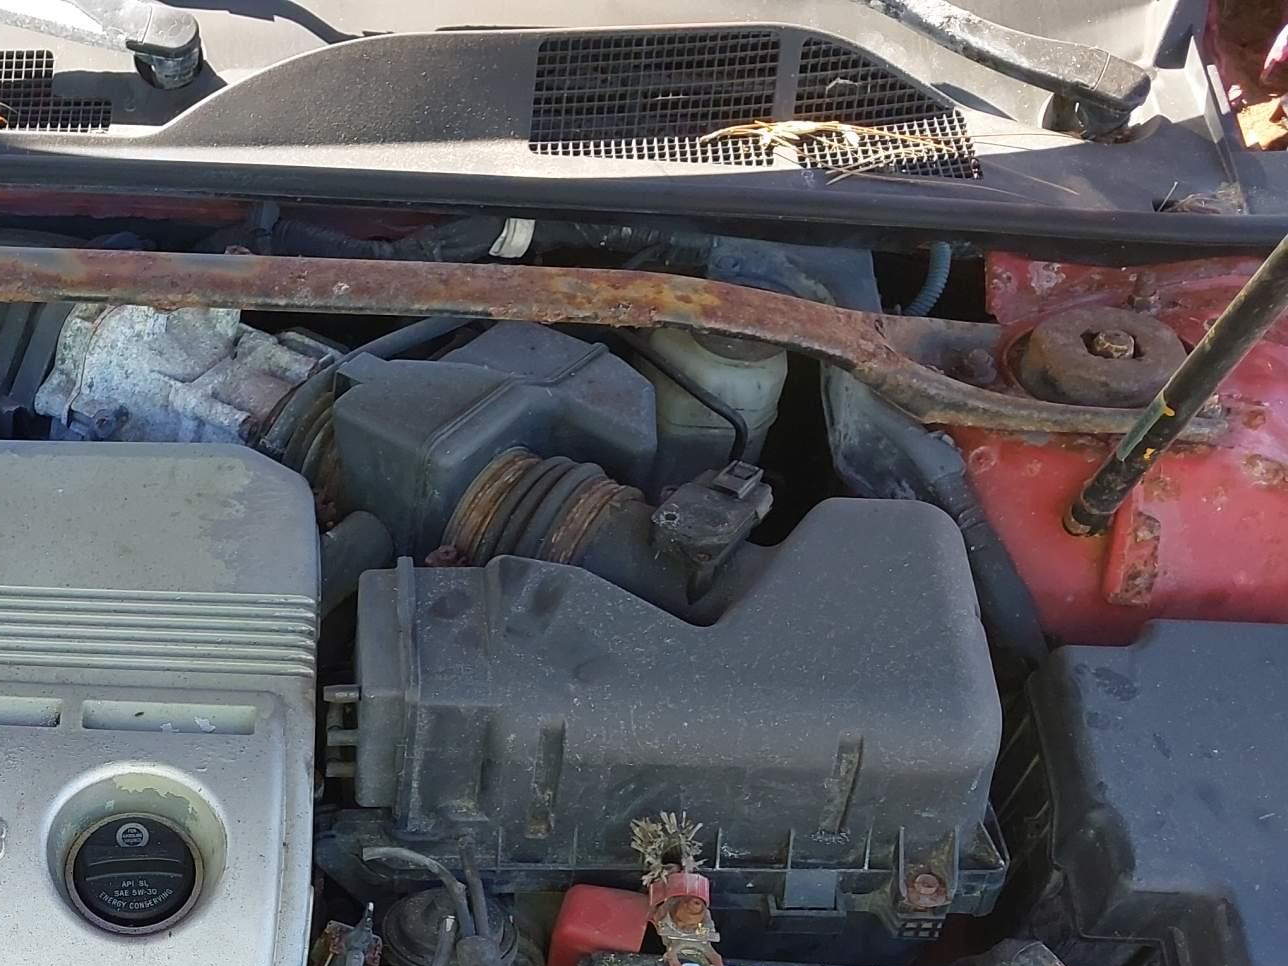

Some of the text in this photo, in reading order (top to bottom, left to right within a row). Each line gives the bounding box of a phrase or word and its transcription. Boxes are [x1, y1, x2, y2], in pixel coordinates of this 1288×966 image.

[121, 880, 135, 888] API
[131, 888, 158, 896] 5W-30
[98, 888, 174, 910] ENERGY CONSERVING
